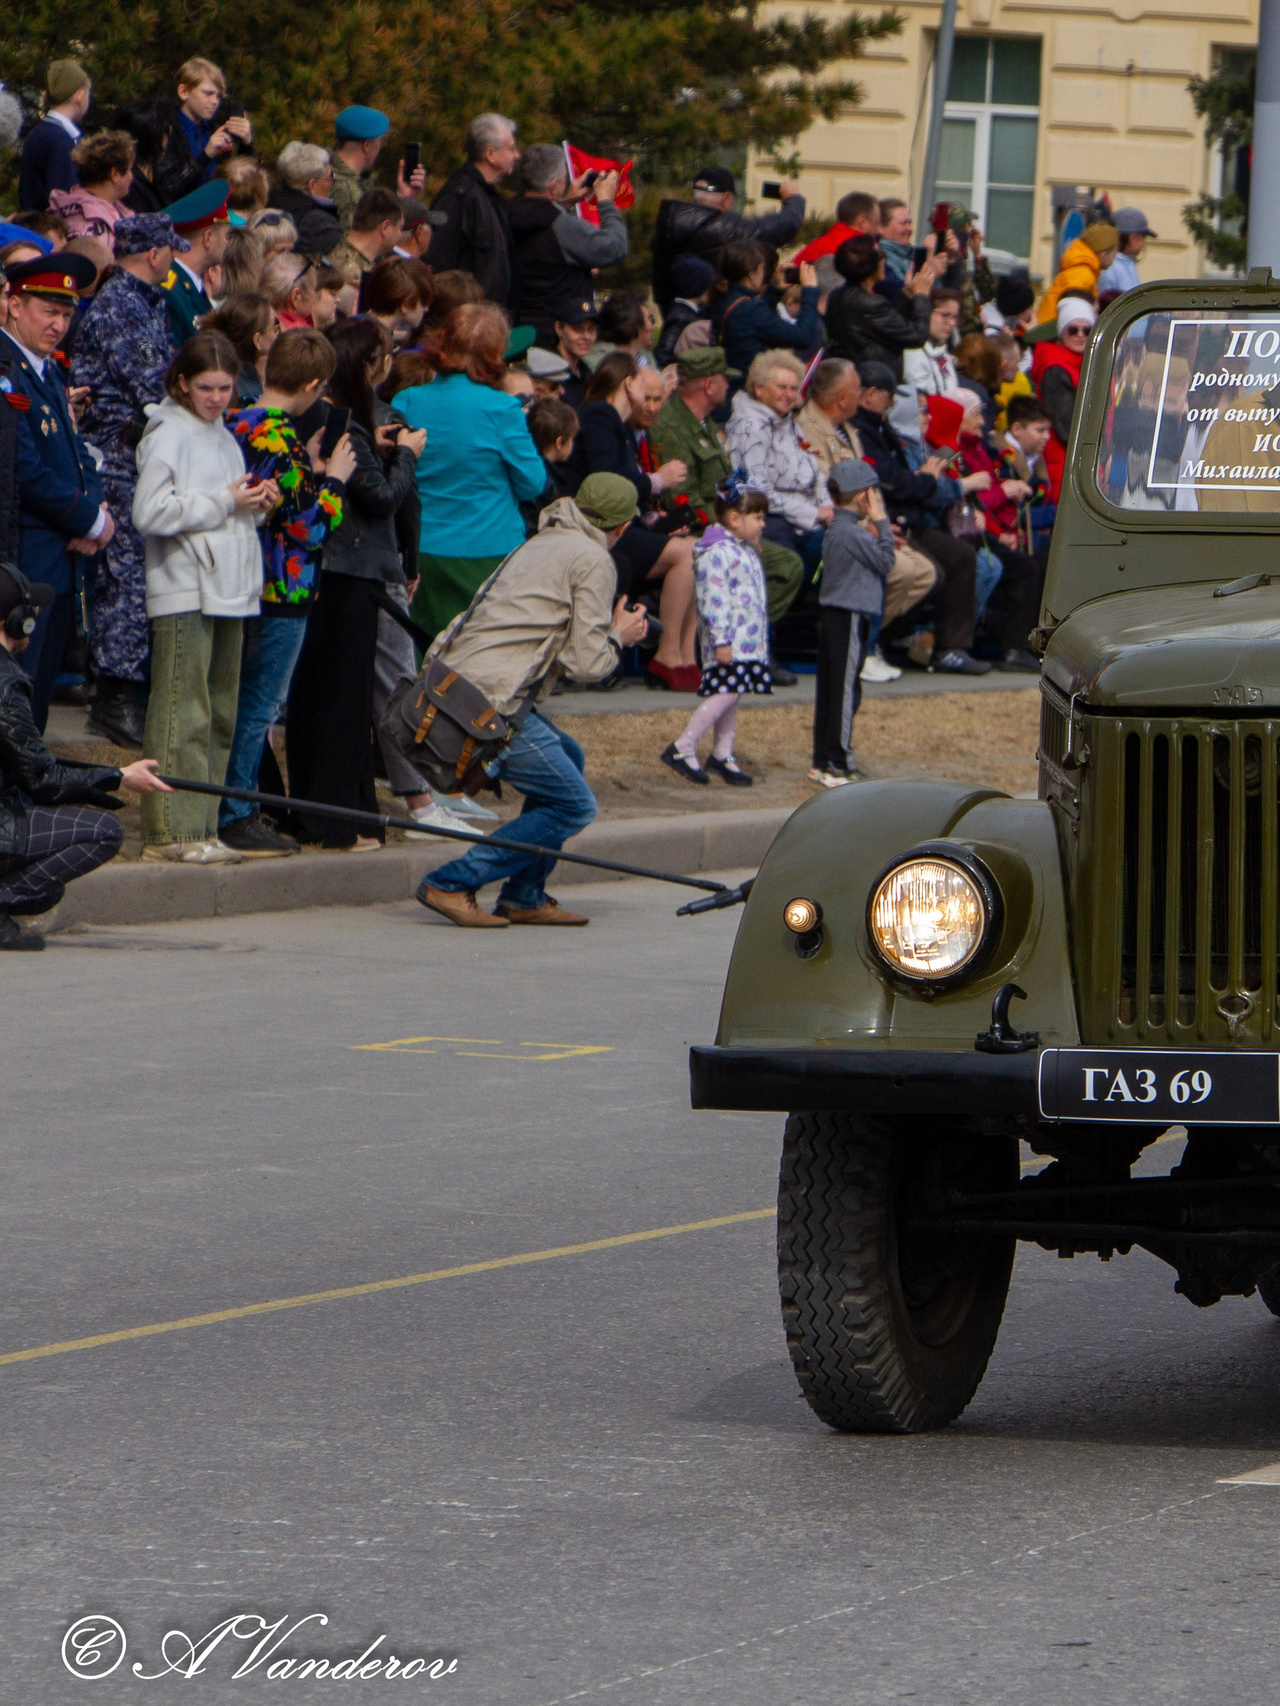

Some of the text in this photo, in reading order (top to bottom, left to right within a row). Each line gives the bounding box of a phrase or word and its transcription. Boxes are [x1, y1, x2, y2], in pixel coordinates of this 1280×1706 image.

[1187, 404, 1220, 422] от
[1181, 460, 1280, 480] Михаила
[1082, 1068, 1213, 1105] ГАЗ 69
